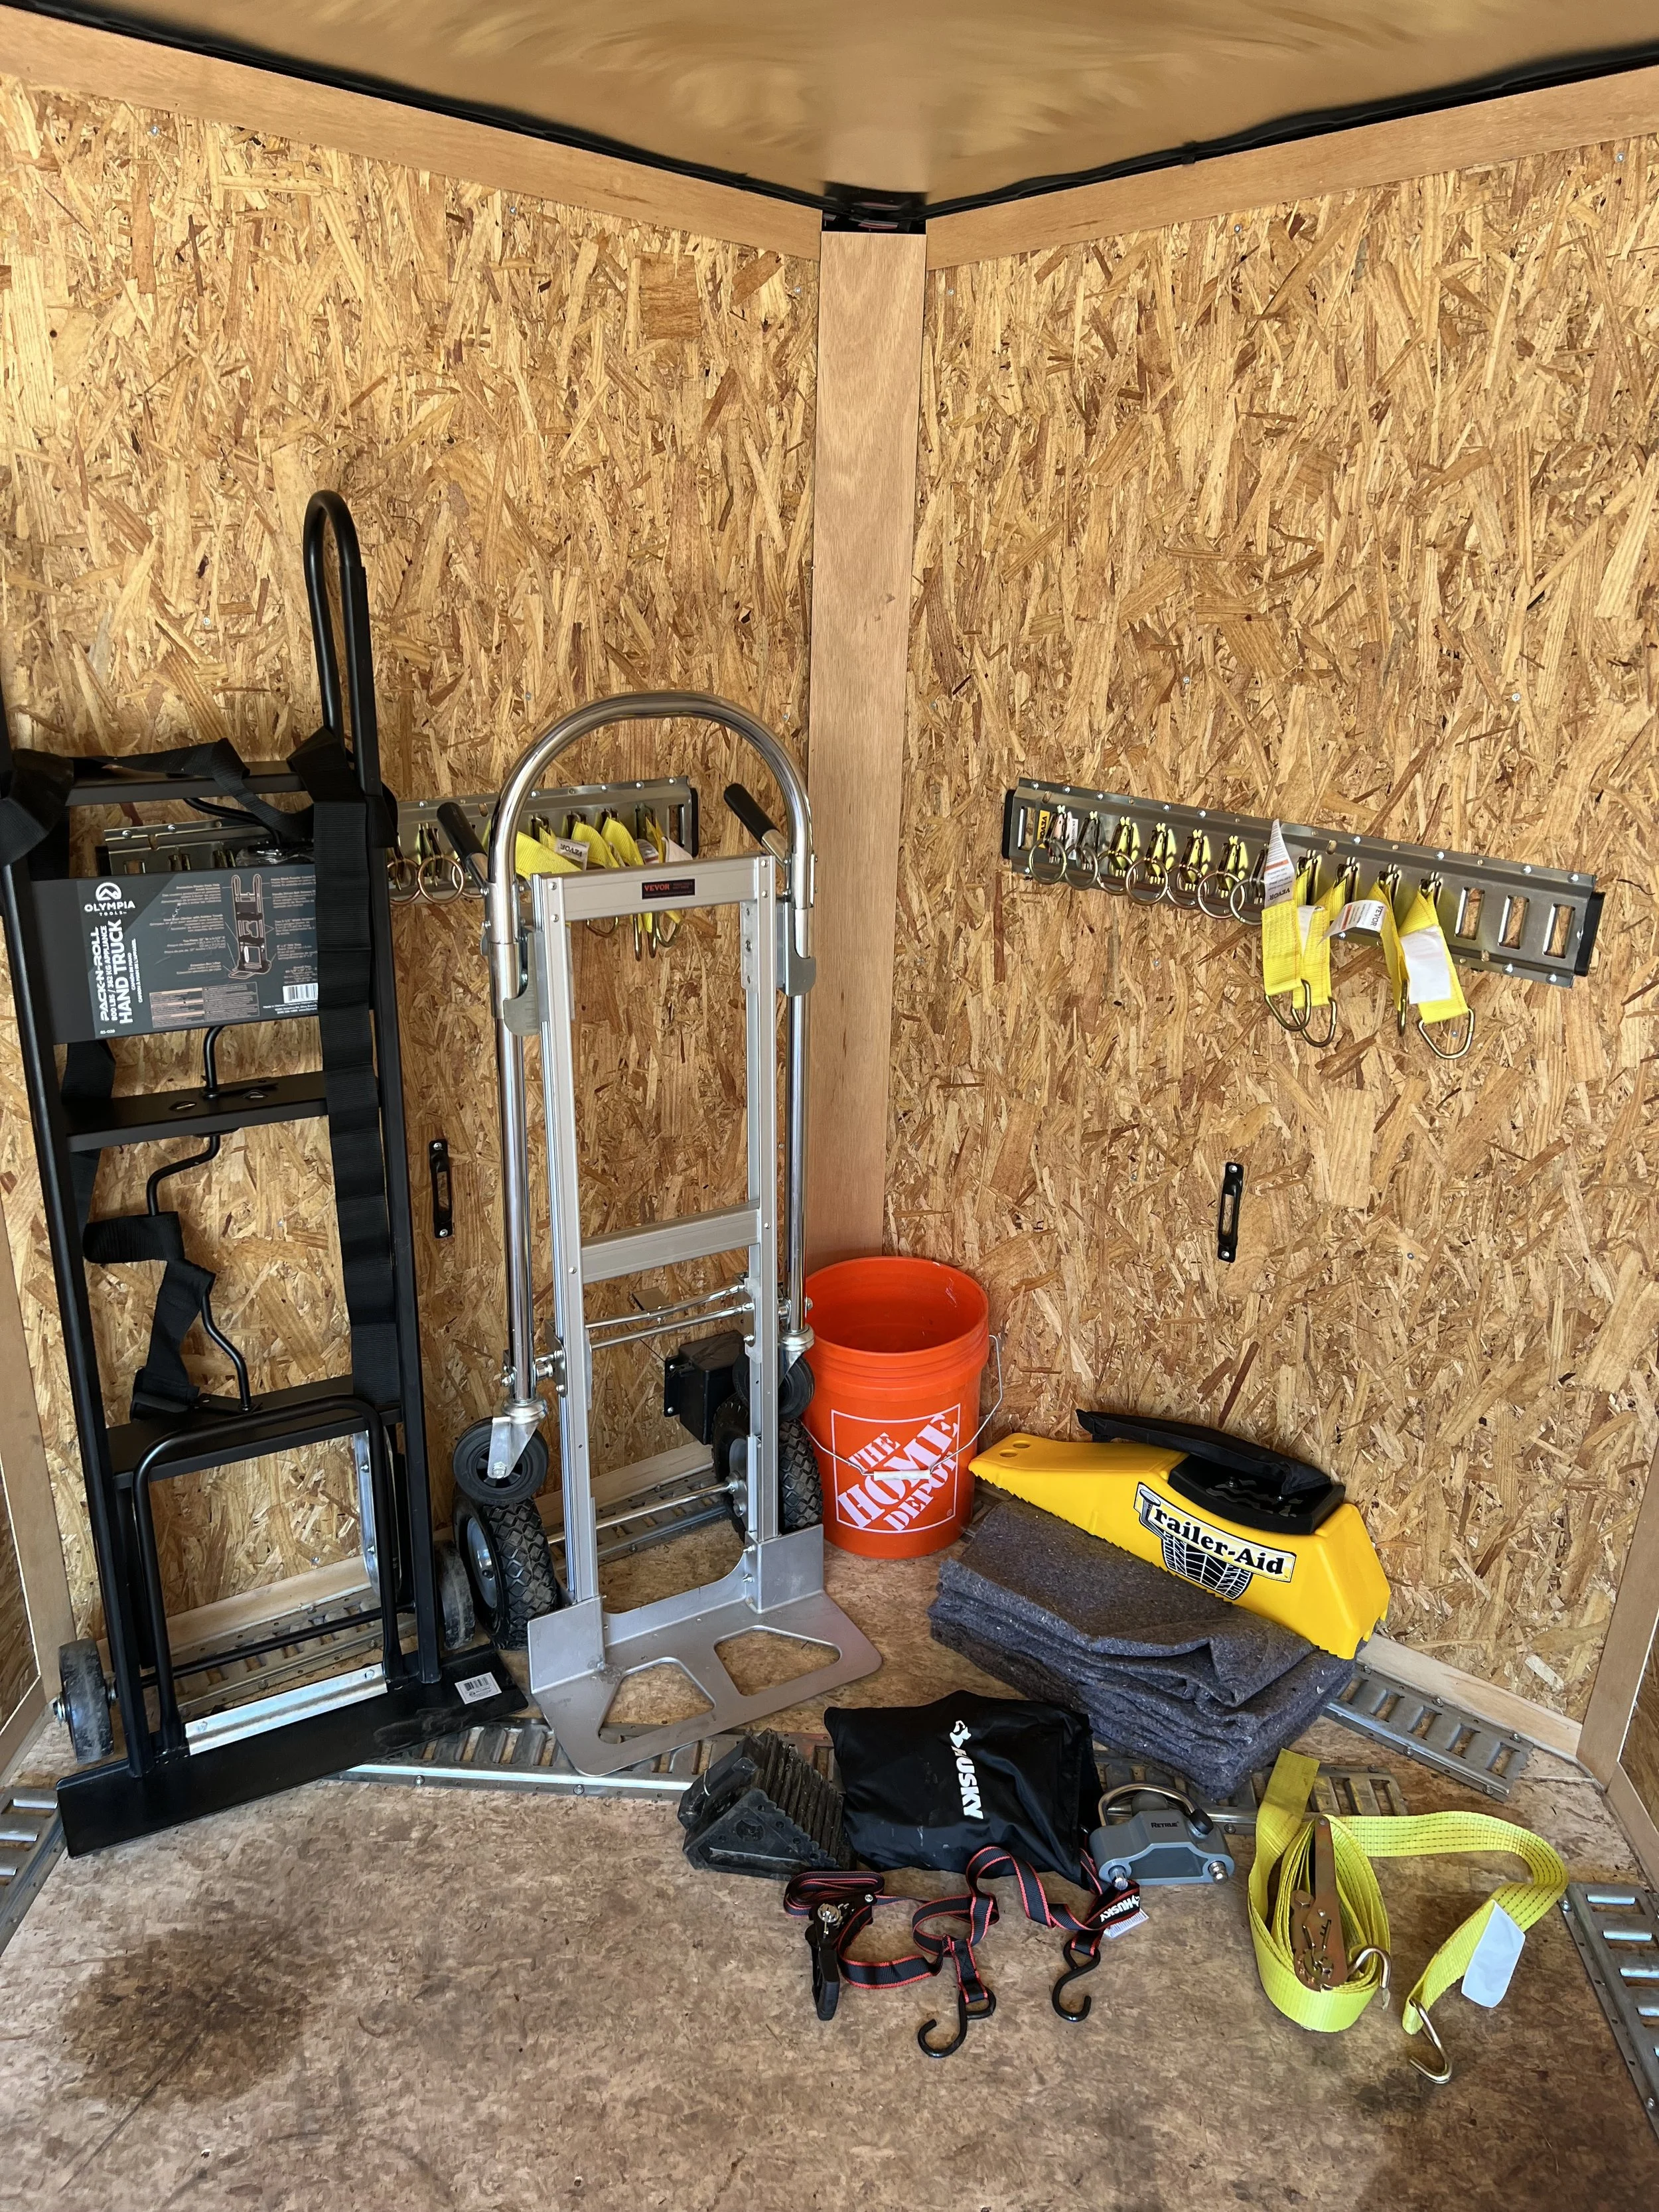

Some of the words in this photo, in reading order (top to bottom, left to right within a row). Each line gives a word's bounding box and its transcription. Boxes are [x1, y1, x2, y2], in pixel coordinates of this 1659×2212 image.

[559, 844, 583, 857] VEVOR
[84, 900, 136, 913] OLYMPIA
[644, 883, 670, 892] VEVOR
[1269, 887, 1291, 901] VEVOR
[1370, 906, 1384, 927] VEVOR
[100, 925, 111, 964] APPLIANCE
[108, 919, 127, 975] TRUCK
[90, 926, 110, 1021] PACK-N-ROLL
[105, 964, 112, 975] KG
[115, 976, 133, 1024] HAND
[838, 1414, 959, 1528] HOME
[846, 1432, 901, 1473] THE
[883, 1451, 956, 1532] DEPOT
[1139, 1489, 1285, 1576] Trailer-Aid
[951, 1745, 984, 1820] HUSKY
[1099, 1898, 1134, 1923] HUSKY
